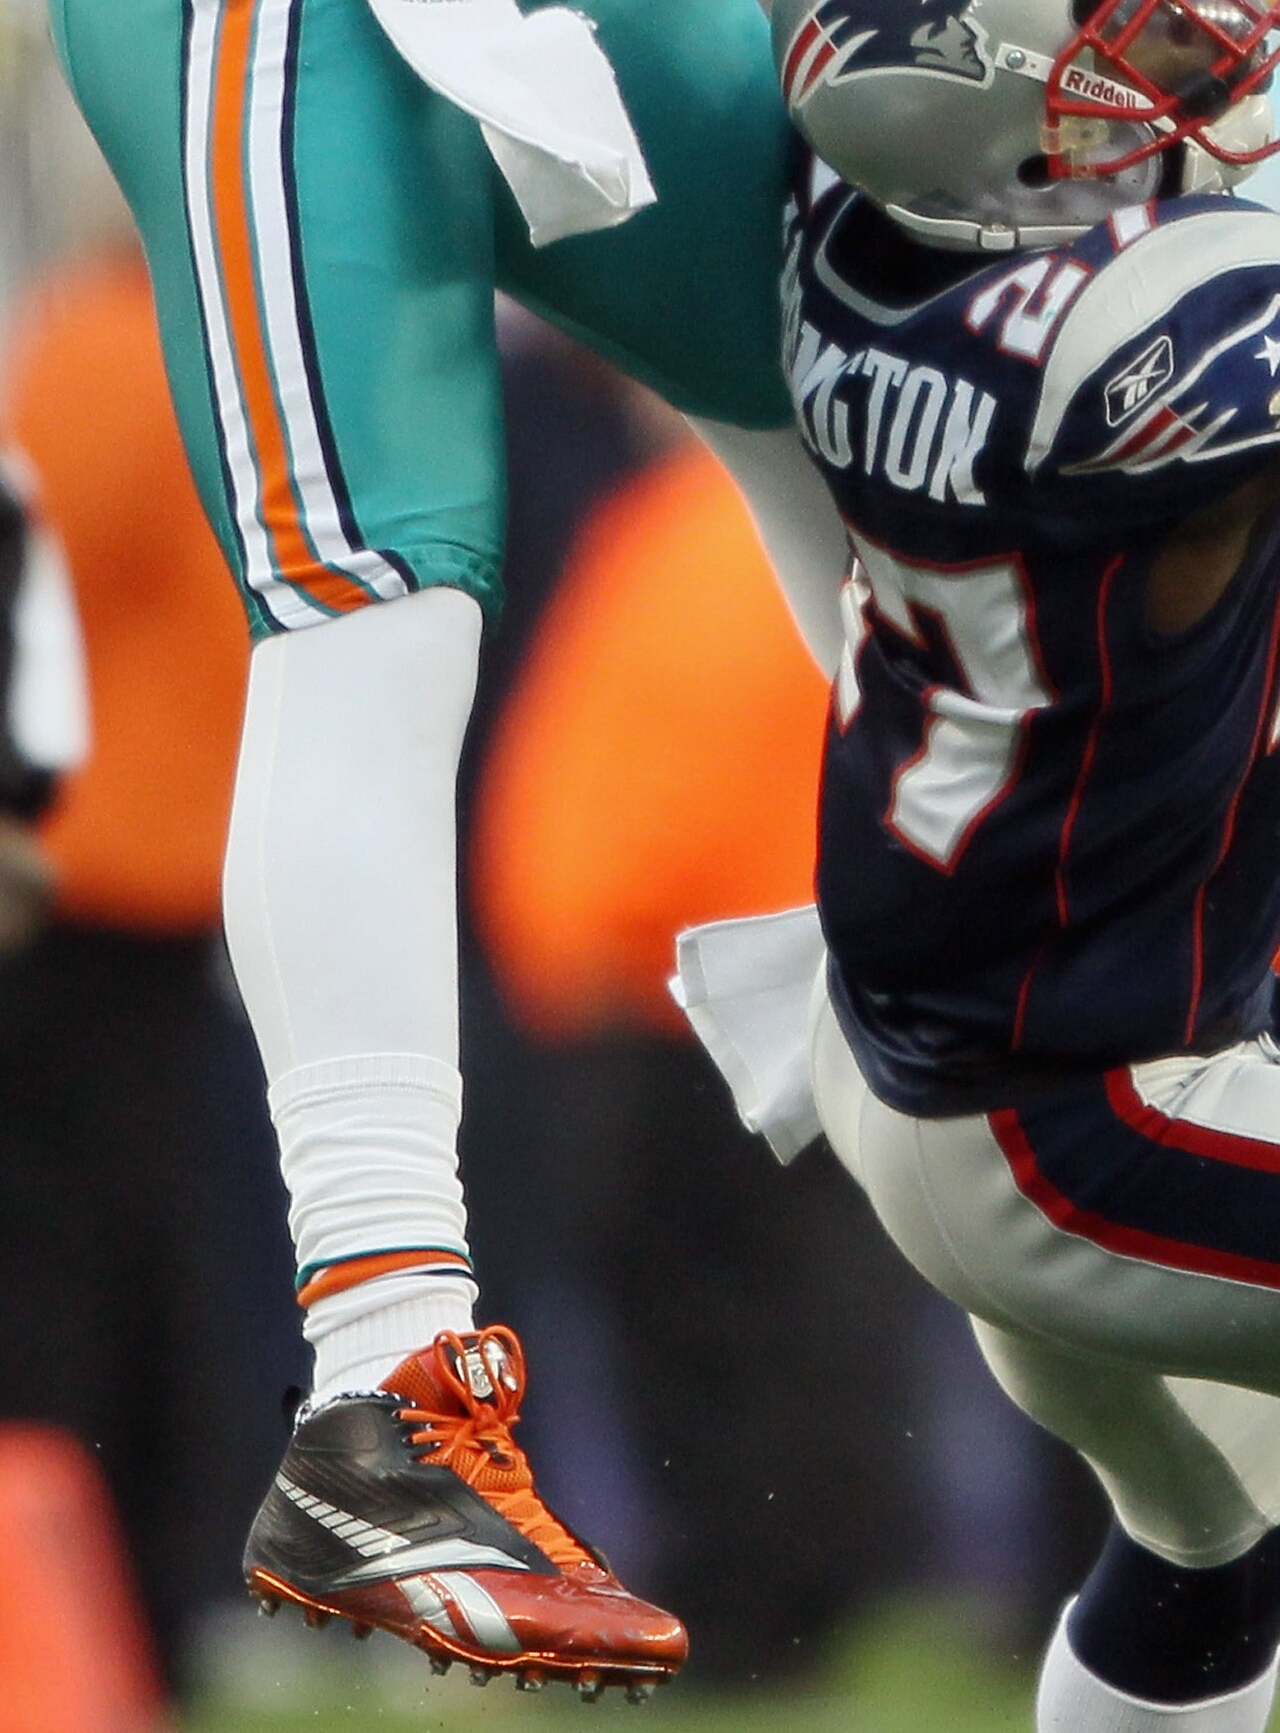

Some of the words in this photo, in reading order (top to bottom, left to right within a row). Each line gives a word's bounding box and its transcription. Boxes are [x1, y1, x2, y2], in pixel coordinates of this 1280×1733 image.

[1065, 69, 1137, 108] Riddell
[783, 272, 996, 506] NGTON
[838, 529, 1058, 875] 7
